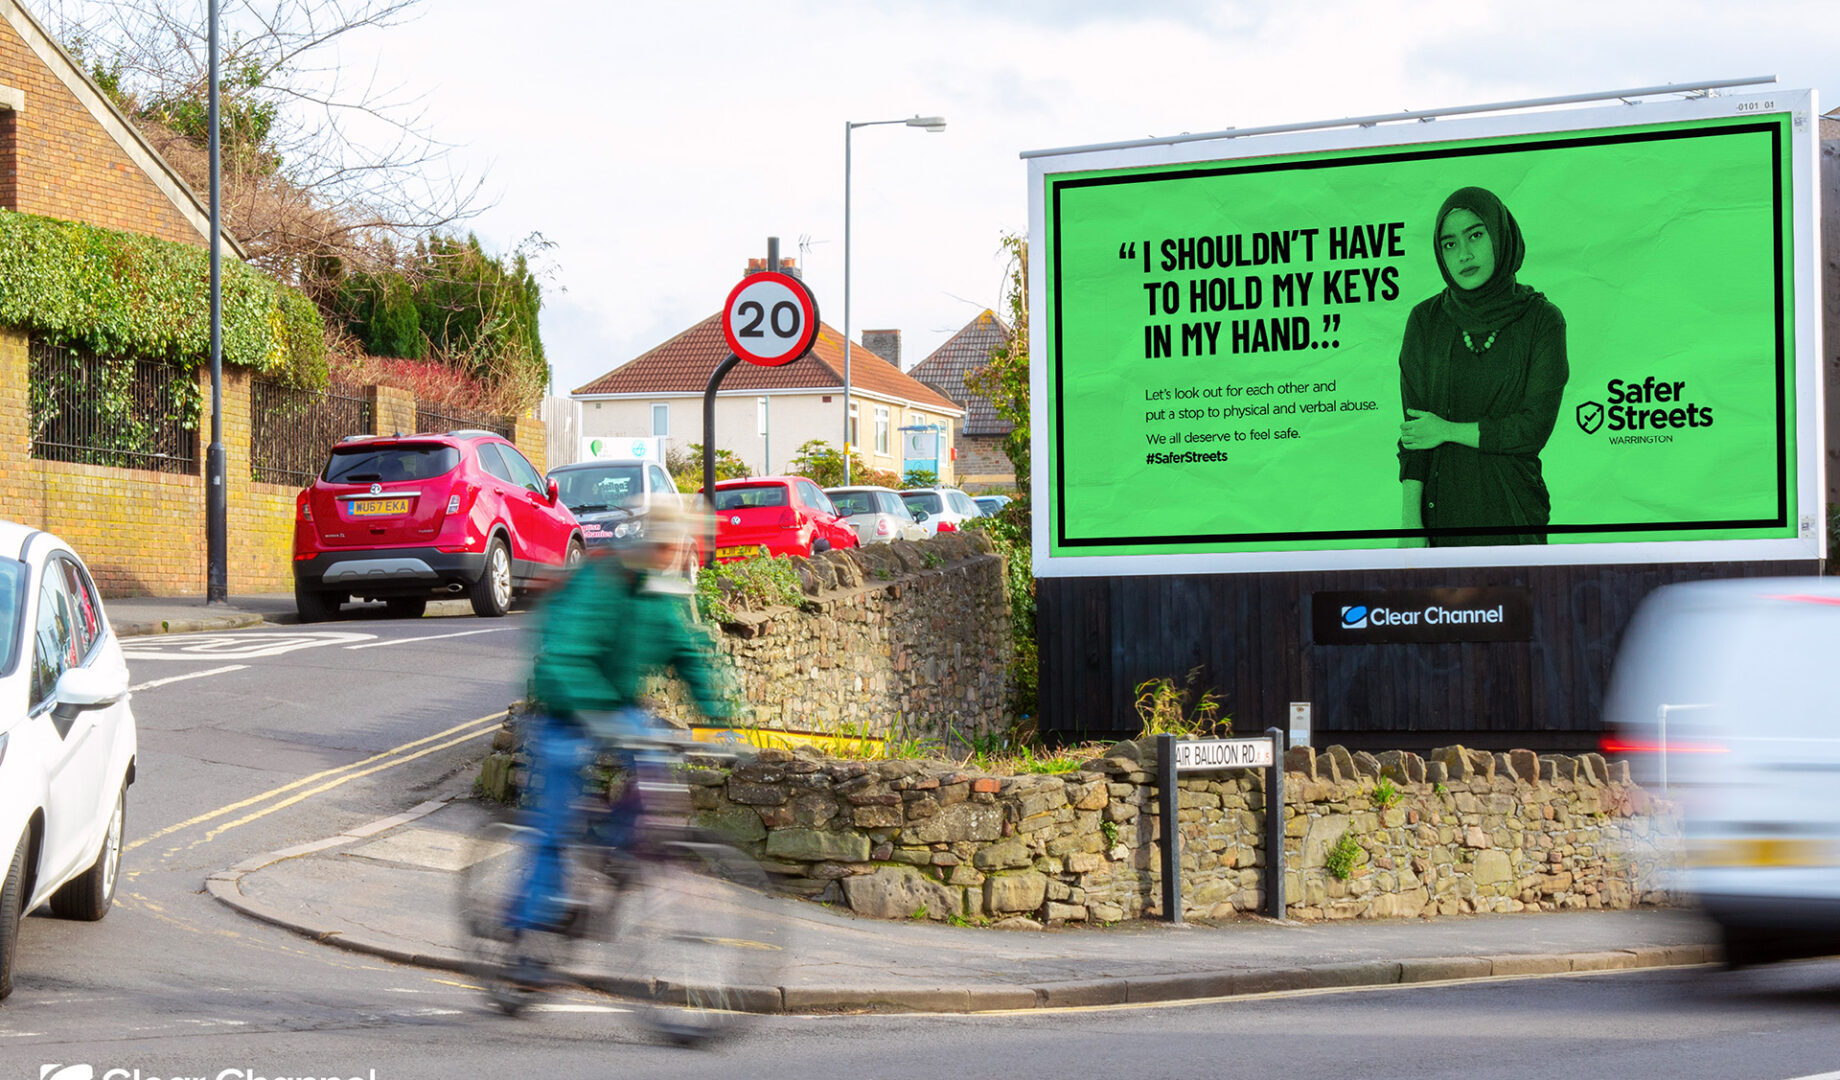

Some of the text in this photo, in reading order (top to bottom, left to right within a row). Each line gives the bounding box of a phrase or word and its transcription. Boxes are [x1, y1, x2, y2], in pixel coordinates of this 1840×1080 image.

[1160, 228, 1319, 272] SHOULDN’T
[1329, 222, 1405, 260] HAVE
[1143, 266, 1400, 316] TO HOLD MY KEYS
[738, 300, 800, 338] 20
[1145, 324, 1171, 359] IN
[1182, 321, 1222, 357] MY
[1145, 379, 1336, 401] Let’s look out for each other and
[1607, 376, 1685, 404] Safer
[1145, 399, 1379, 423] put a stop to physical and verbal abuse.
[1607, 403, 1713, 431] Streets
[1145, 427, 1301, 445] We all deserve to feel safe.
[1609, 435, 1673, 445] WARRINGTON
[1146, 451, 1229, 465] #SaferStreets
[385, 501, 406, 512] EKA
[1370, 605, 1503, 626] Clear Channel
[1176, 746, 1191, 767] AIR
[1195, 744, 1239, 766] BALLOON
